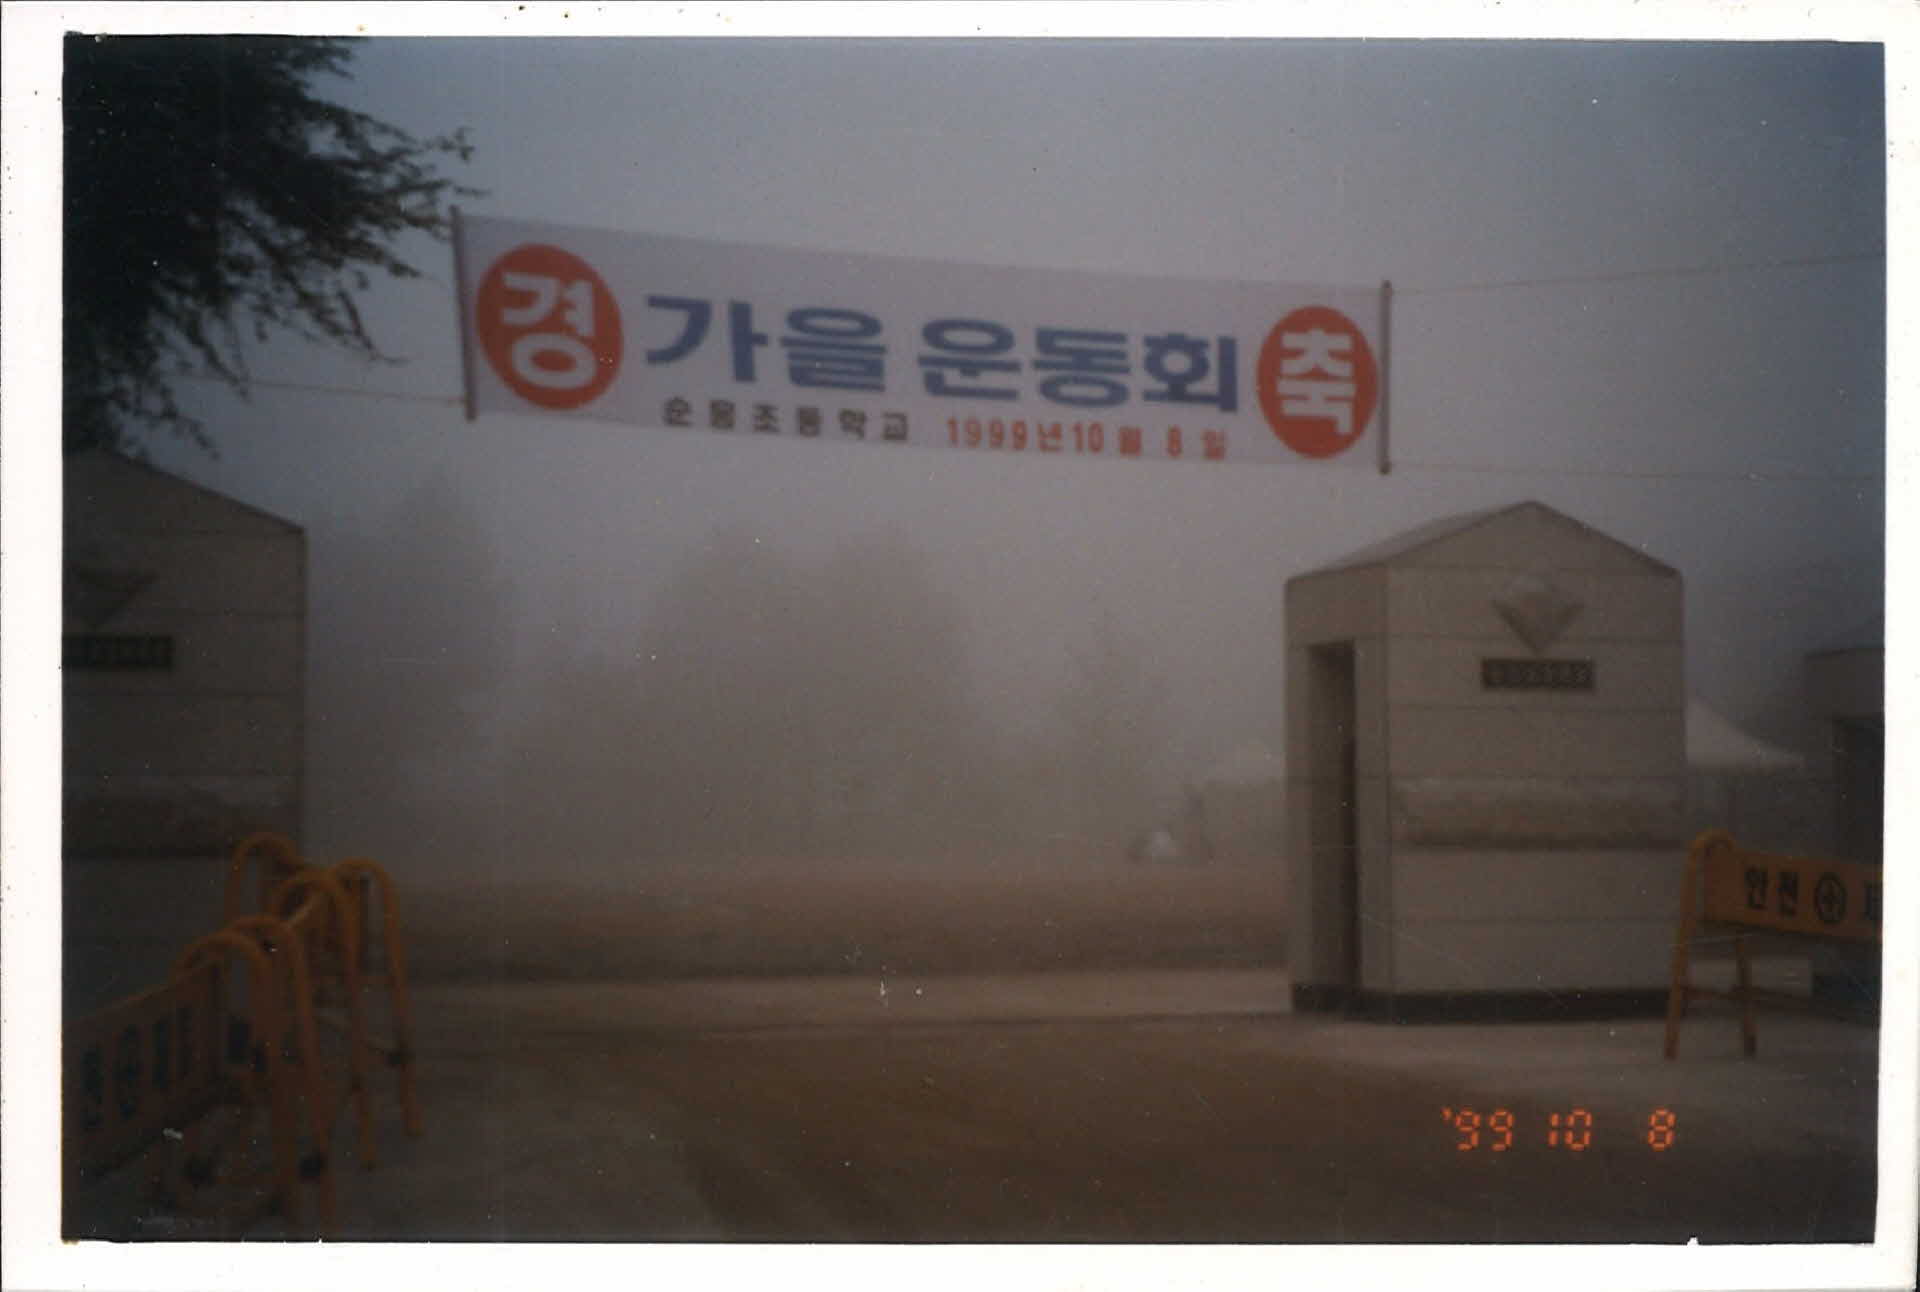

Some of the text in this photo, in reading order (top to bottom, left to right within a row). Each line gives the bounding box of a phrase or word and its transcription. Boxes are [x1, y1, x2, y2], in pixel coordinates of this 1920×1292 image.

[502, 271, 1359, 436] 경 가을 운동회 축
